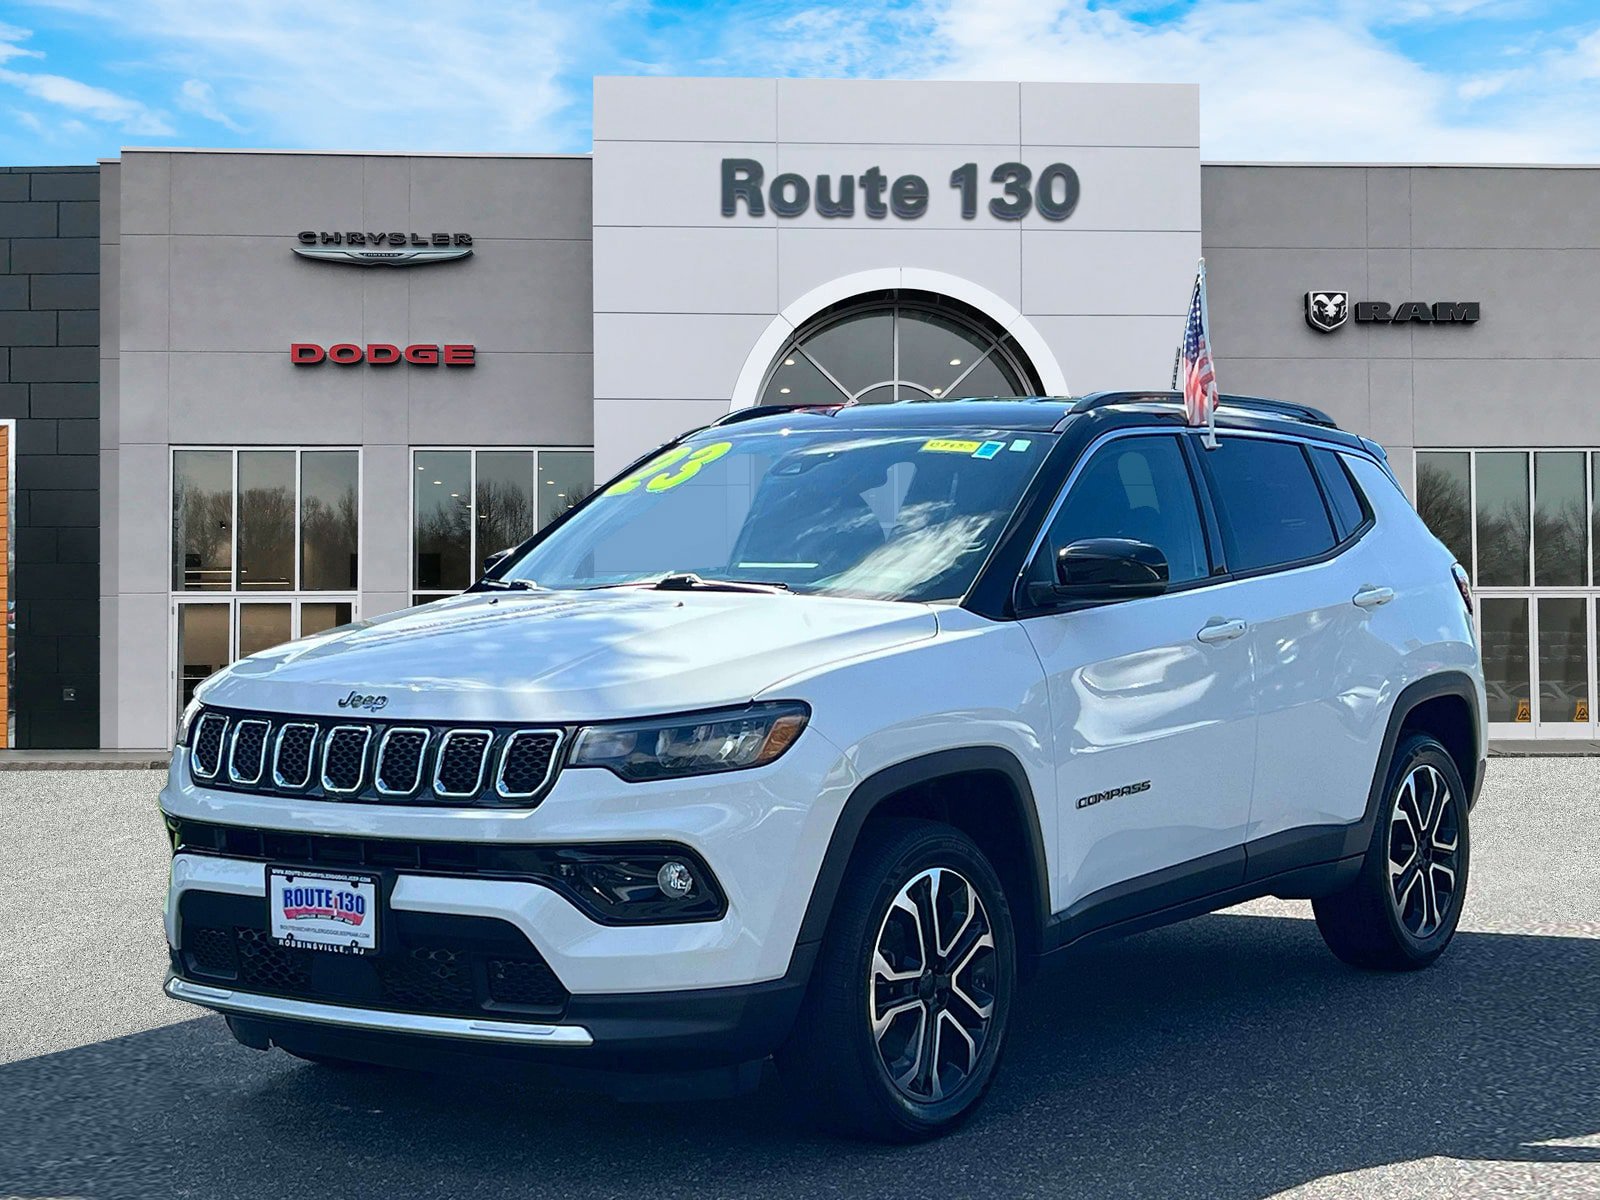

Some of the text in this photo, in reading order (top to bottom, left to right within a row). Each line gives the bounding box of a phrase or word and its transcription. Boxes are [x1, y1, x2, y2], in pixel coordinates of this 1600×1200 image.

[721, 158, 1080, 221] Route 130
[298, 231, 473, 246] CHRYSLER
[1354, 301, 1480, 324] RAM
[291, 343, 475, 366] DODGE
[602, 441, 733, 497] 23
[338, 690, 389, 713] Jeep
[1075, 780, 1152, 810] COMPASS
[283, 888, 365, 914] ROUTE 130
[353, 946, 365, 955] NJ
